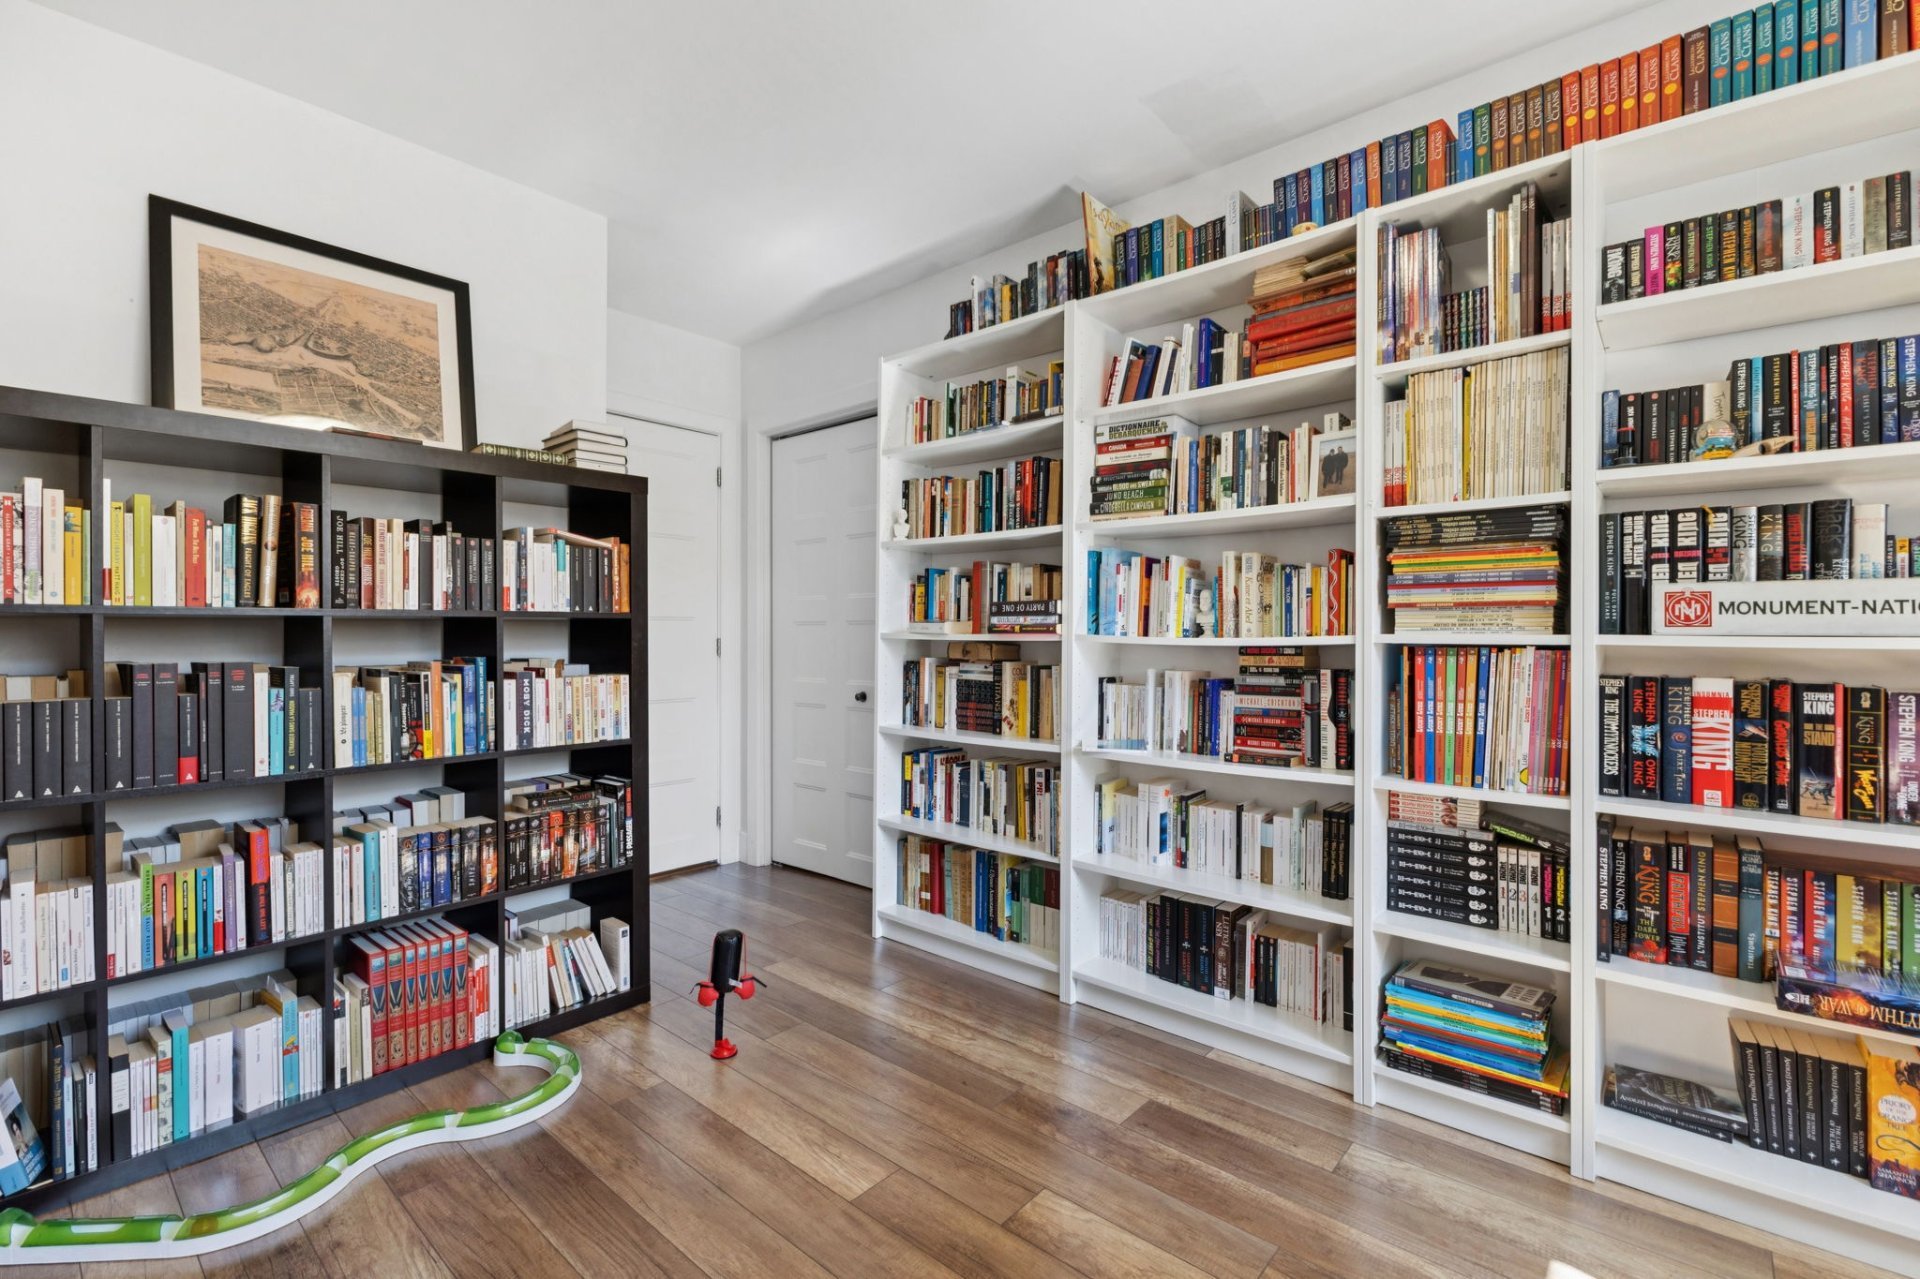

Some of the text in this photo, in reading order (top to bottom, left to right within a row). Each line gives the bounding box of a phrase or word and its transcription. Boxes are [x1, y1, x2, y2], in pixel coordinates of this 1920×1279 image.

[1740, 24, 1752, 58] CLANS
[1761, 21, 1772, 48] CLANS
[1784, 14, 1794, 41] CLANS
[1694, 40, 1705, 74] CLANS
[1718, 31, 1730, 65] CLANS
[1648, 58, 1658, 90] CLANS
[1670, 48, 1680, 80] CLANS
[1588, 76, 1598, 106] CLANS
[1606, 71, 1618, 102] CLANS
[1626, 64, 1636, 96] CLANS
[1550, 90, 1560, 120] CLANS
[1569, 84, 1579, 114] CLANS
[1823, 202, 1832, 228] STEPHEN
[1794, 206, 1802, 255] STEPHEN KING
[1723, 232, 1735, 264] STEPHEN
[1808, 353, 1816, 398] STEPHEN KING
[1840, 348, 1851, 402] STEPHEN KING
[1887, 342, 1896, 388] STEPHEN KING
[1905, 338, 1917, 396] STEPHEN KING
[1737, 362, 1746, 408] STEPHEN KING
[1108, 420, 1160, 432] DICTIONNAIRE
[1100, 501, 1129, 514] CINDERELLA
[1104, 490, 1144, 501] JUNO BEACH
[336, 516, 344, 554] JOE HILL
[1606, 521, 1614, 555] STEPHEN
[1624, 517, 1632, 564] STEPHEN KING
[1634, 516, 1644, 564] PETER STRAUB
[1651, 514, 1668, 548] KING
[1678, 512, 1698, 546] KING
[1708, 512, 1728, 547] KING
[1732, 515, 1747, 548] KING
[1761, 514, 1771, 552] KING
[244, 548, 252, 568] FLIGHT
[300, 536, 314, 572] JOE HILL
[364, 534, 372, 560] JOE HILL
[244, 569, 252, 577] OF
[364, 564, 372, 586] HORNS
[1002, 604, 1014, 612] ONE
[1016, 604, 1024, 612] OF
[1718, 600, 1920, 615] MONUMENT-NATI
[1600, 678, 1624, 686] STEPHEN
[1605, 686, 1618, 694] KING
[1804, 692, 1834, 700] STEPHEN
[1239, 697, 1263, 706] MICHAEL
[1604, 699, 1619, 714] THE
[1634, 690, 1642, 712] KING
[1646, 682, 1656, 722] STEPHEN
[1668, 686, 1682, 725] KING
[1693, 710, 1732, 718] STEPHEN
[1740, 690, 1749, 711] KING
[1804, 700, 1834, 715] KING
[1804, 730, 1834, 746] STAND
[1898, 696, 1916, 762] STEPHEN KING
[1692, 720, 1730, 770] KING
[1634, 761, 1642, 784] KING
[1646, 760, 1656, 788] OWEN
[1734, 741, 1750, 782] MIDNIGHT
[1751, 743, 1768, 784] FOUR PAST
[1907, 781, 1918, 802] UNDER
[626, 850, 633, 858] LE
[1500, 887, 1506, 898] 1
[1510, 888, 1516, 900] 2
[1600, 848, 1611, 910] STEPHEN KING
[1615, 850, 1625, 908] STEPHEN KING
[1636, 865, 1660, 904] KING
[1520, 890, 1526, 901] 3
[1532, 892, 1538, 904] 4
[1545, 907, 1552, 918] 1
[1556, 910, 1564, 921] 2
[1222, 915, 1230, 947] FOLLETT
[1818, 995, 1852, 1016] WAR
[1746, 1048, 1756, 1100] ANDRZEJ SAPKOWSKI
[1784, 1057, 1792, 1105] ANDRZEJ SAPKOWSKI
[1854, 1070, 1862, 1122] ANDRZEJ SAPKOWSKI
[1877, 1172, 1916, 1185] SHANNON
